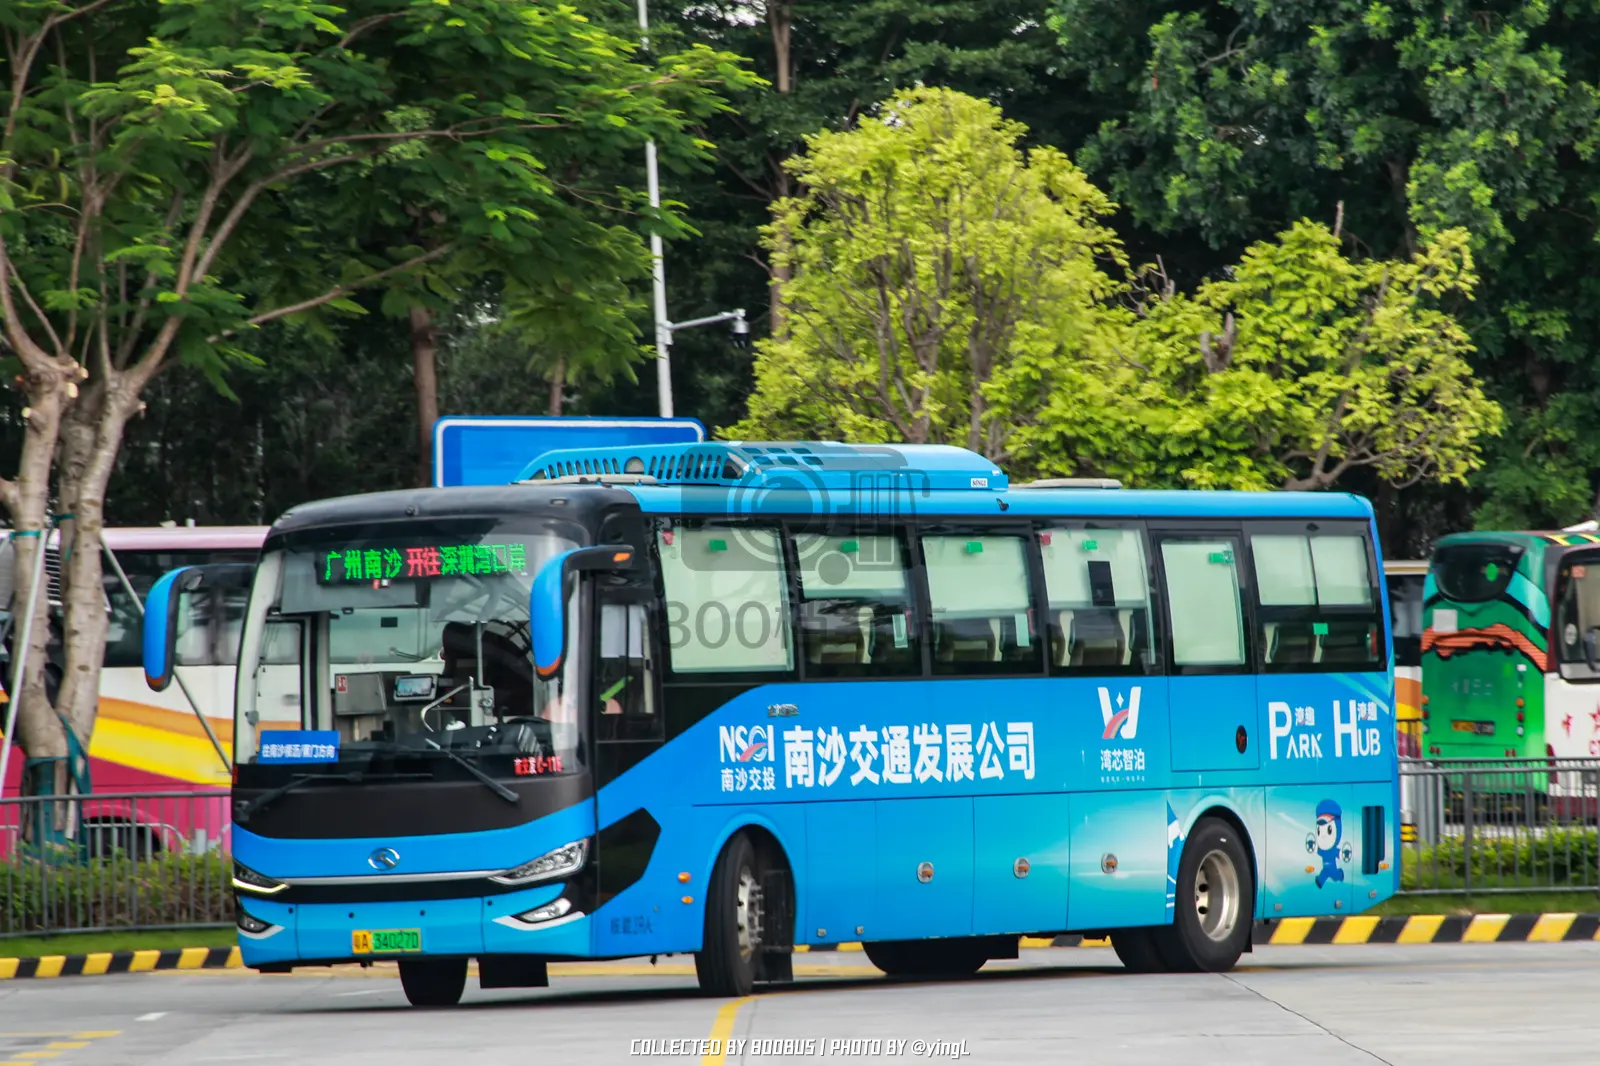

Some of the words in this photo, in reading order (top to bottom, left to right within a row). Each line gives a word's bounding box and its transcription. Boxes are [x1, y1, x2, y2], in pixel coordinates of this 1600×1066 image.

[1268, 702, 1323, 760] PARK
[1333, 699, 1381, 758] HUB
[783, 721, 1036, 789] 南沙交通发展公司
[1100, 748, 1145, 772] 湾芯智泊
[721, 767, 776, 792] 南沙交投
